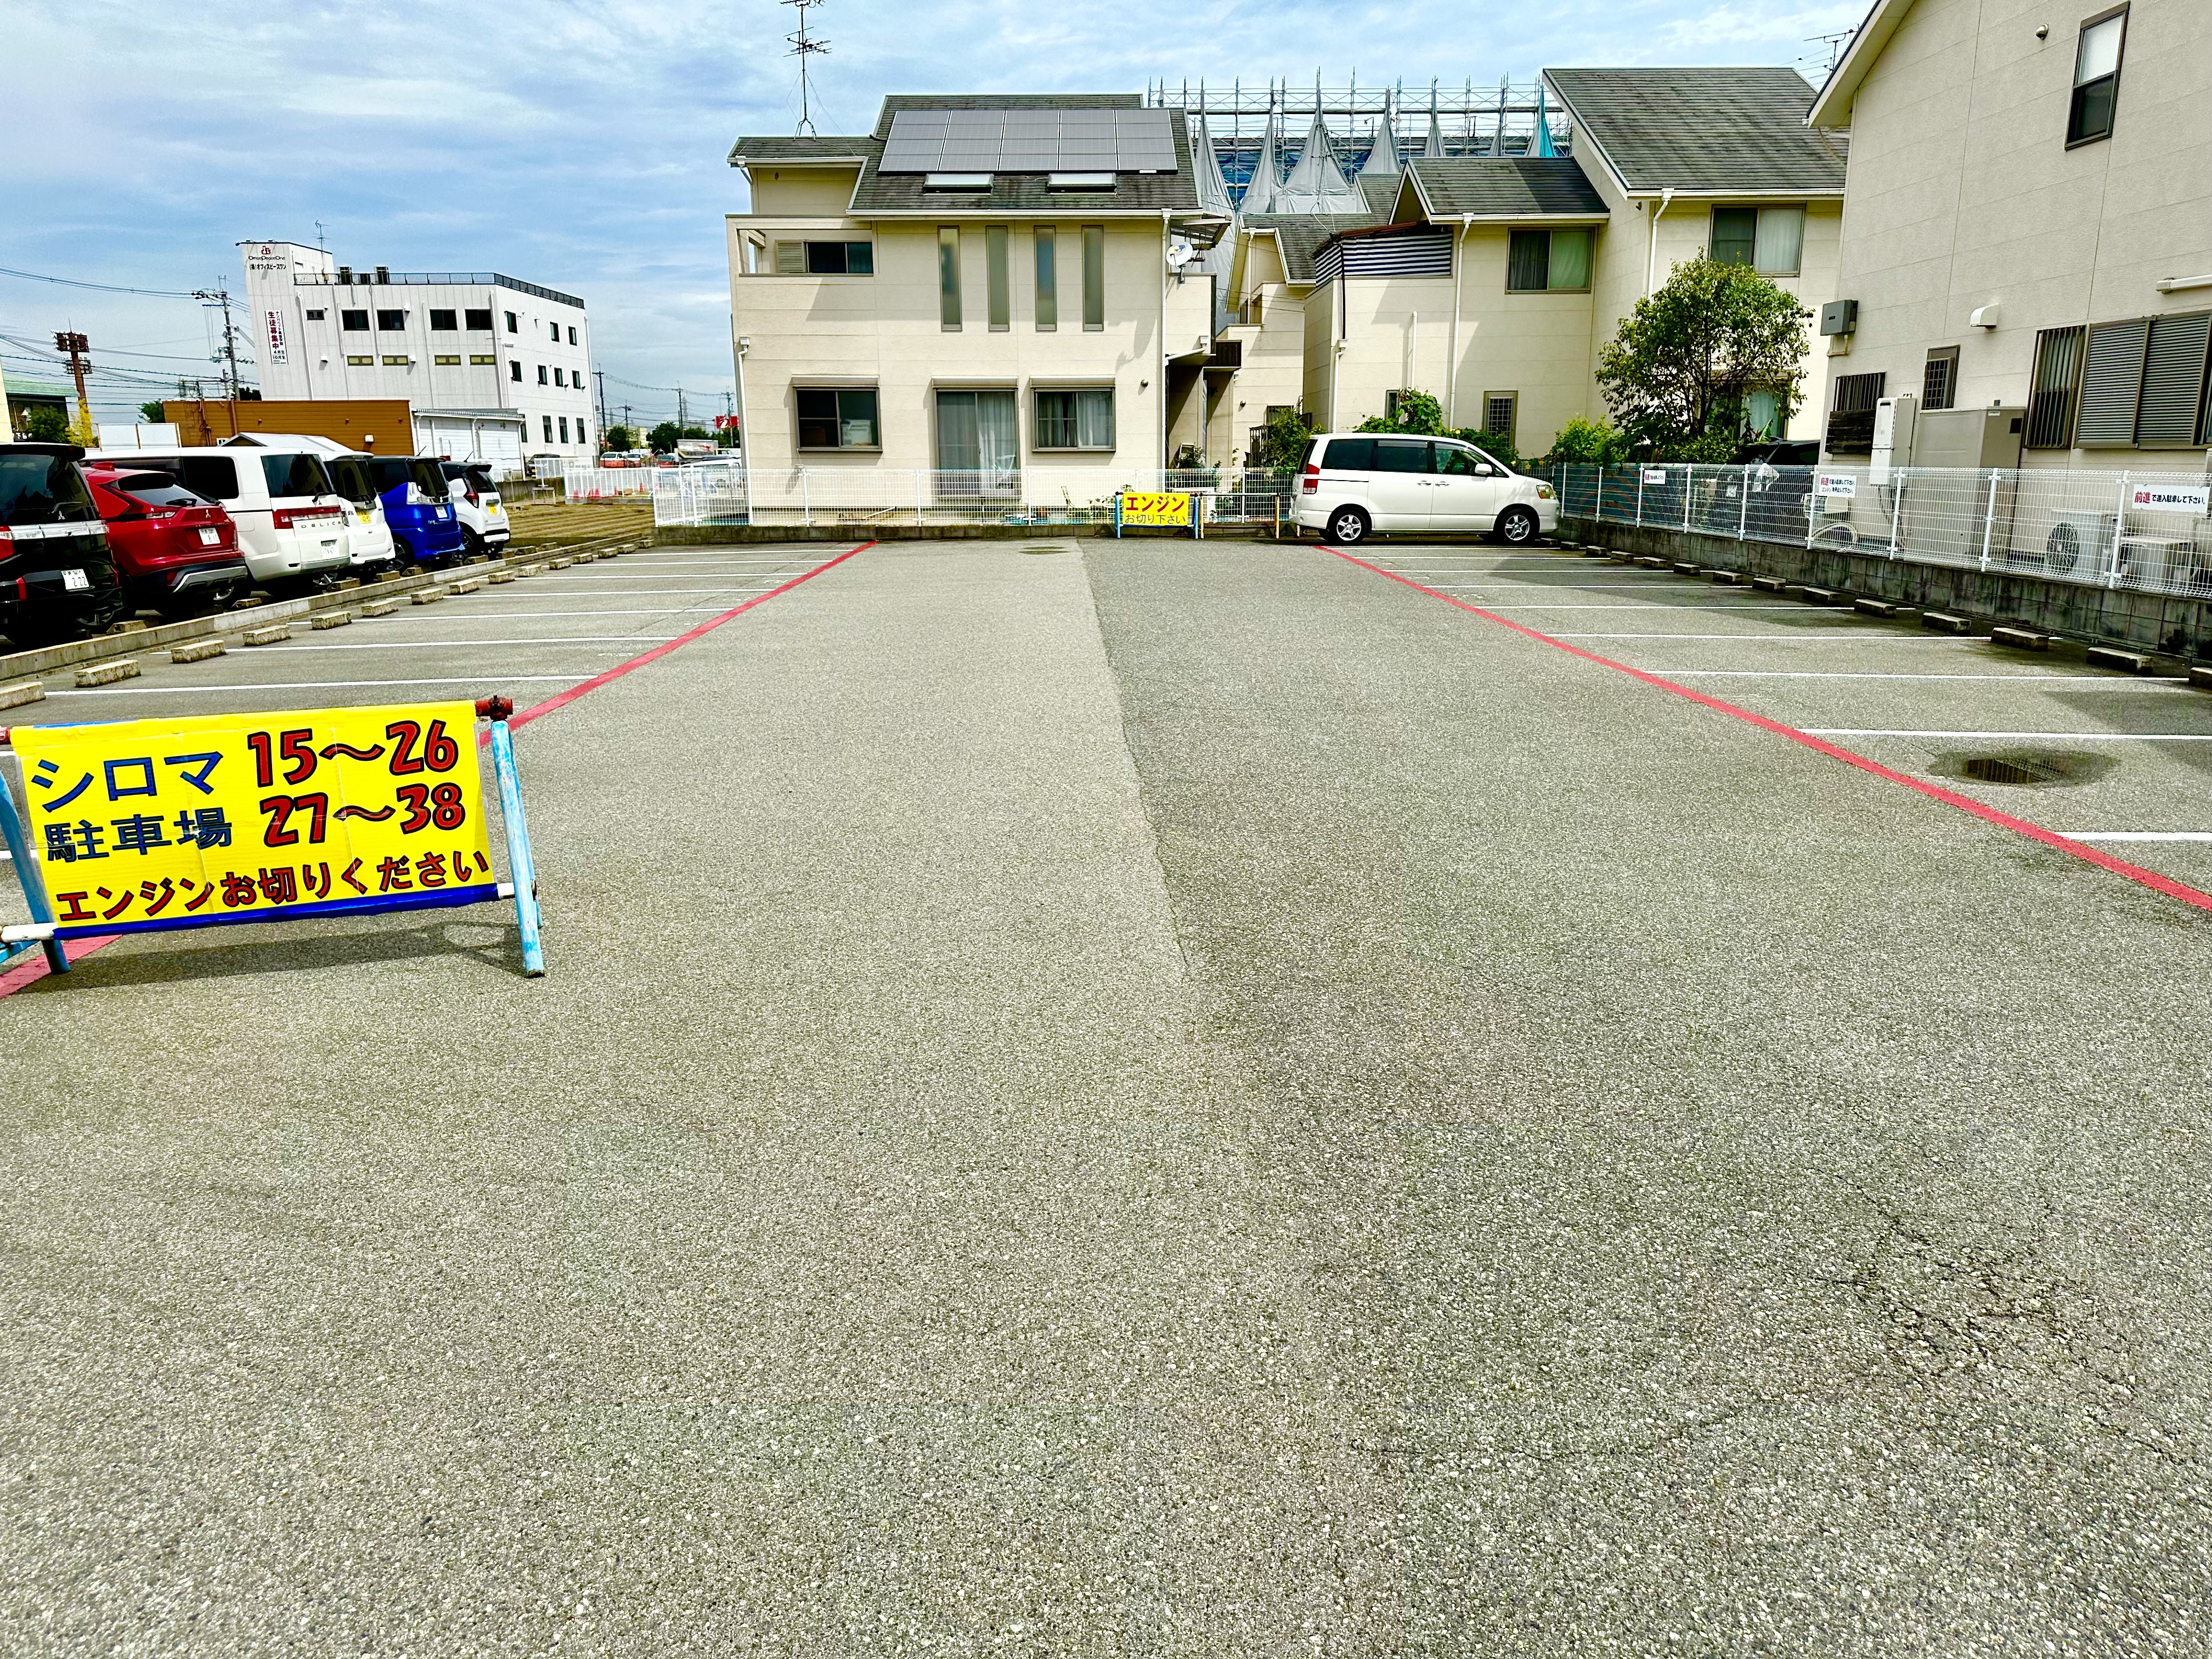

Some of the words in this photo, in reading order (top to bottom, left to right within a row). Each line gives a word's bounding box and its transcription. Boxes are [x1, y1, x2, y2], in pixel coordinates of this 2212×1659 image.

[268, 311, 279, 349] 生徒募集中
[1125, 514, 1186, 524] お切り下さい
[1126, 495, 1185, 513] エンジン
[31, 751, 224, 813] シロマ
[43, 806, 233, 863] 駐車場
[56, 850, 490, 922] エンジンお切りください
